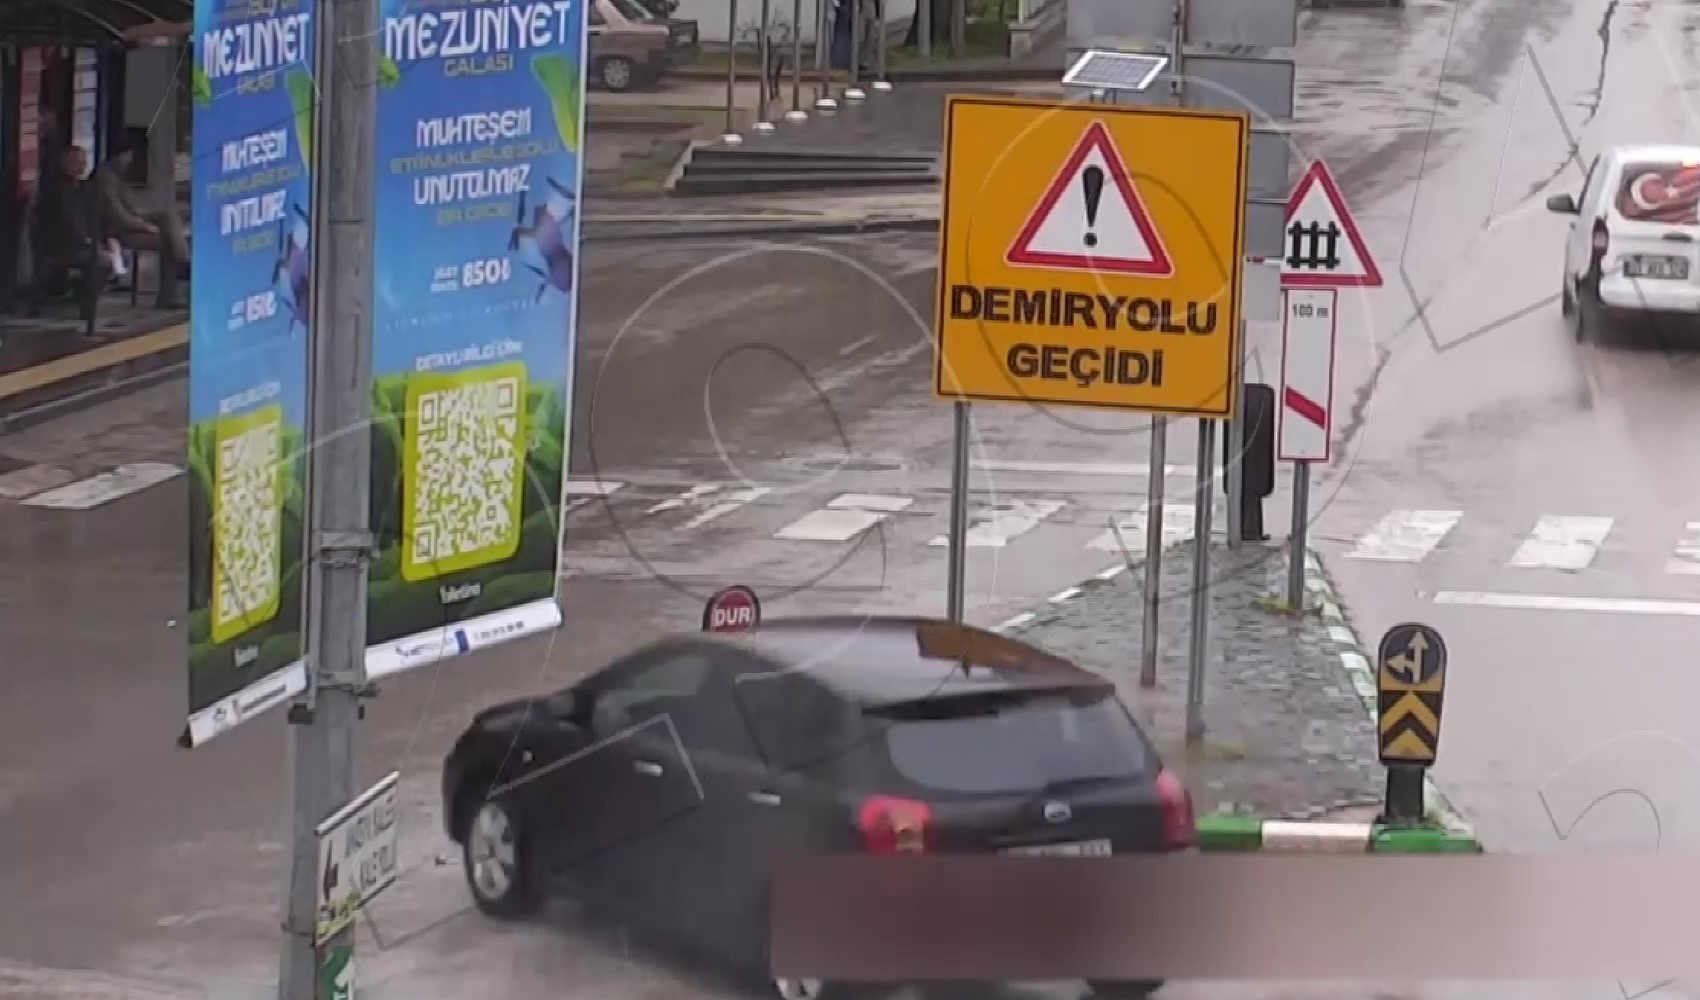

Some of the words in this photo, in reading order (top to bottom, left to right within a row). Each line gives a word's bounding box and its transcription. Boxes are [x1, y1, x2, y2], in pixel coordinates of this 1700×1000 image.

[950, 285, 1217, 335] DEMİRYOLU
[1293, 303, 1313, 319] 100
[1006, 342, 1165, 388] GEÇİDİ
[714, 605, 753, 627] DUR
